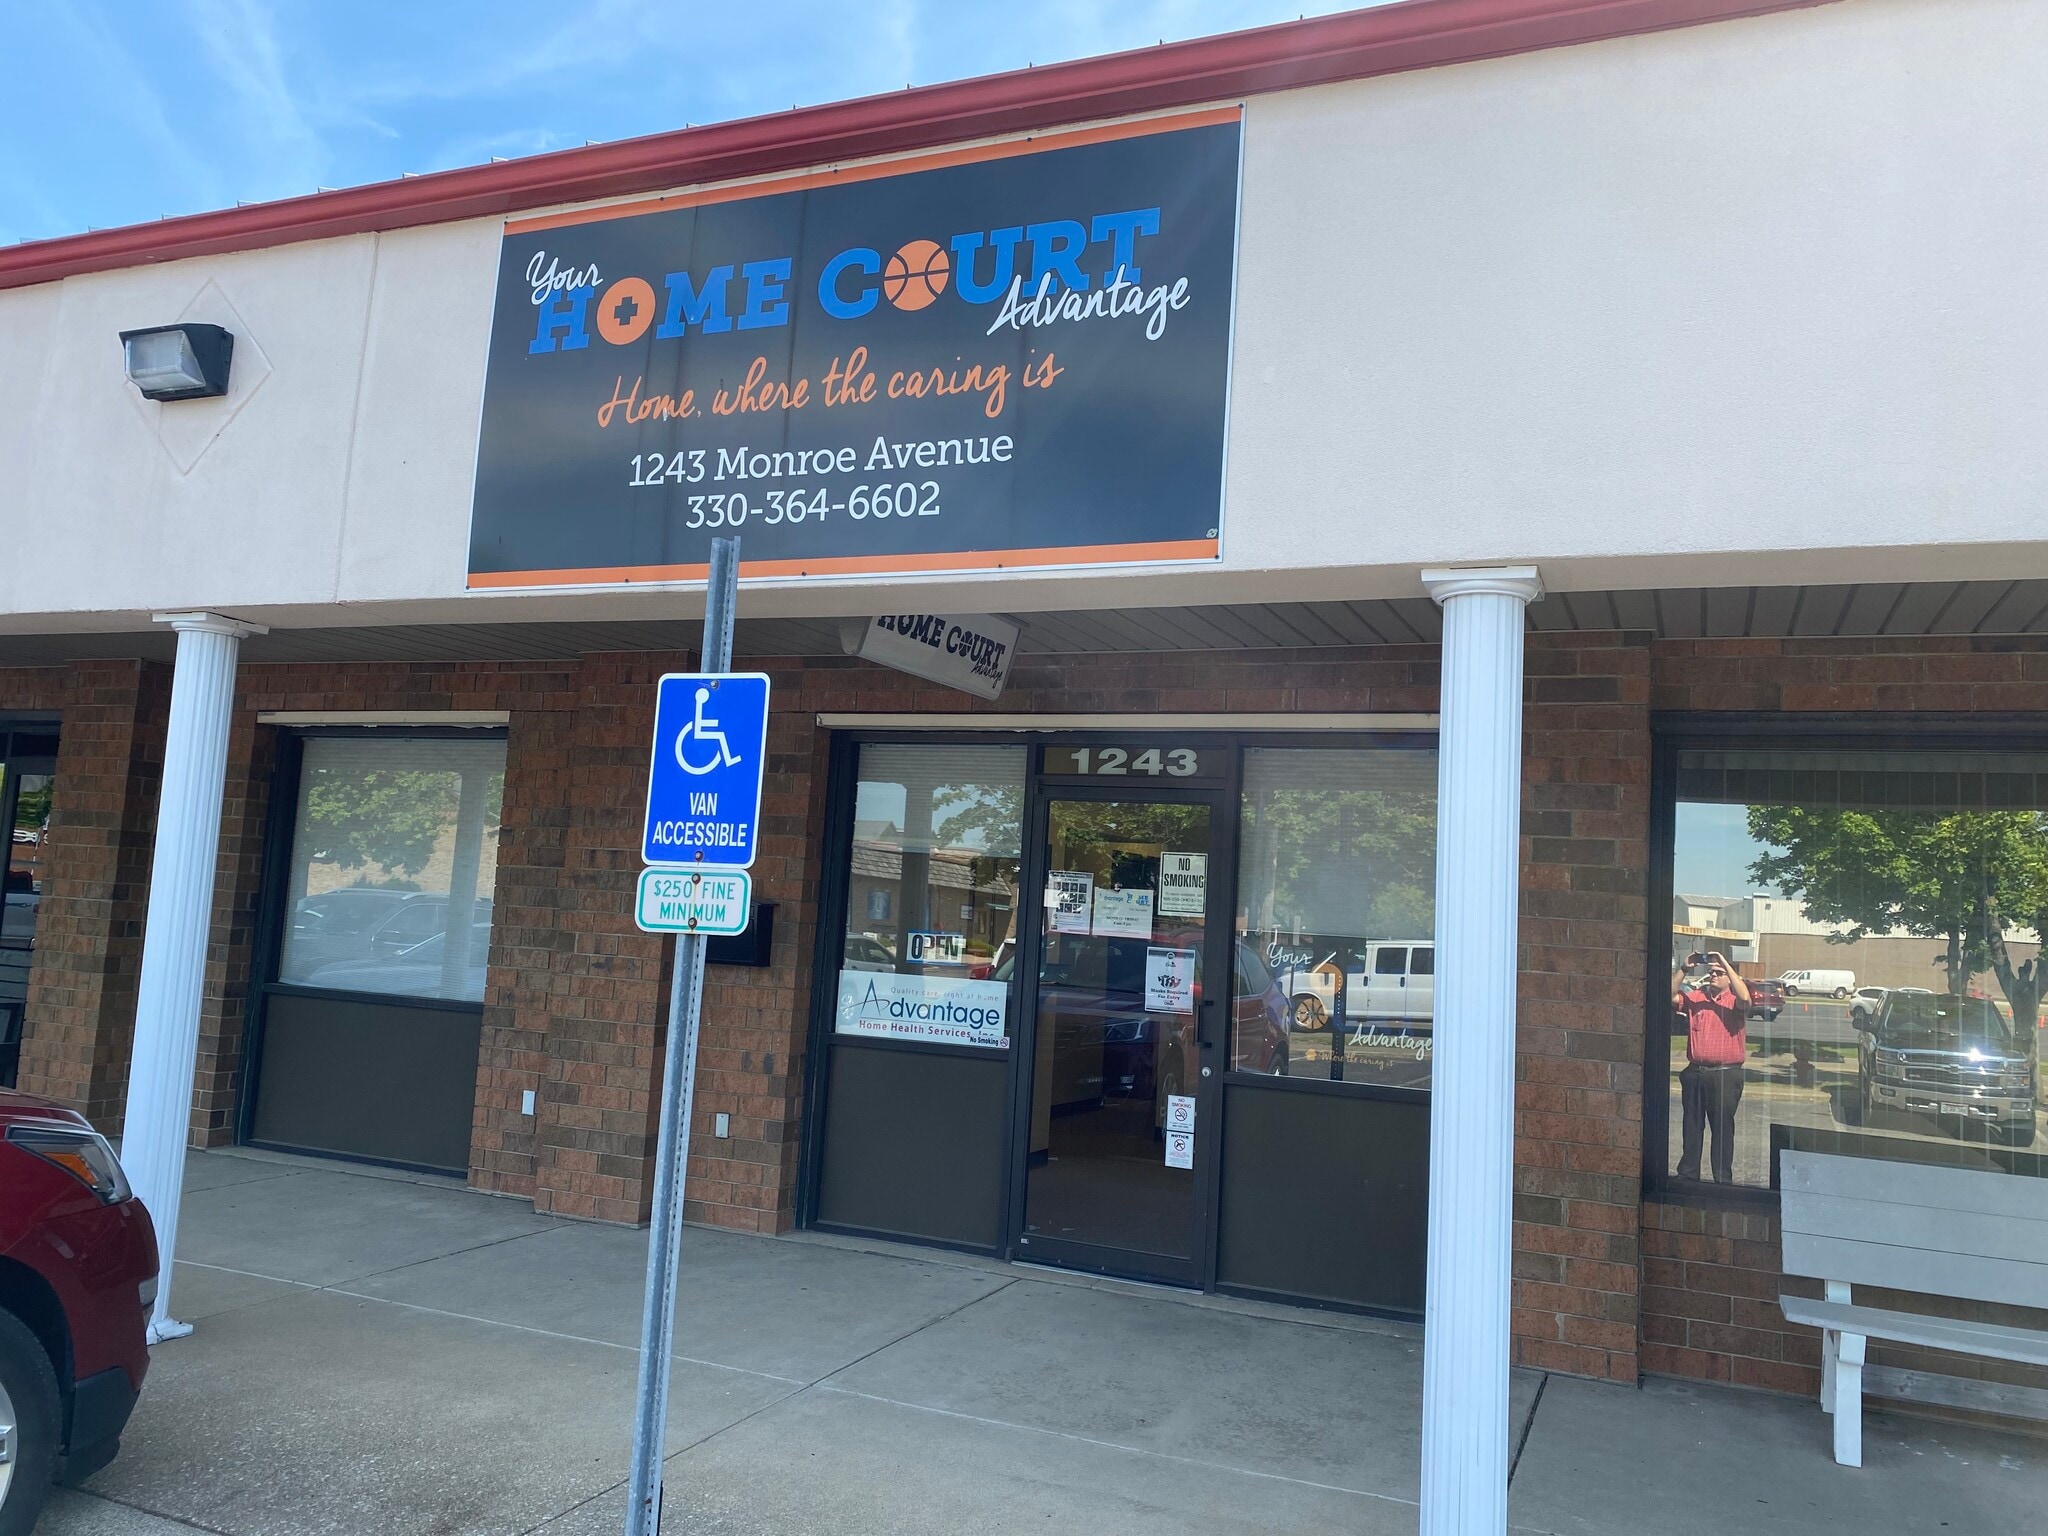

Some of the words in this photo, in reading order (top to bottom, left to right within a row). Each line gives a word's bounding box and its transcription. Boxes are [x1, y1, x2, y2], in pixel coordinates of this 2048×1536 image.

[526, 250, 603, 305] Your
[529, 257, 792, 354] HOME
[818, 207, 1160, 320] COURT
[987, 264, 1191, 340] Advantage
[598, 375, 701, 428] Home,
[712, 357, 809, 415] where
[822, 346, 876, 407] the
[887, 356, 1011, 418] caring
[1023, 348, 1065, 388] is
[629, 449, 706, 487] 1243
[713, 446, 856, 481] Monroe
[864, 434, 1014, 471] Avenue
[685, 480, 941, 529] 330-364-6602
[1071, 748, 1199, 777] 1243
[689, 792, 718, 816] VAN
[652, 821, 748, 847] ACCESSIBLE
[1178, 857, 1191, 871] NO
[653, 879, 693, 899] $250
[702, 881, 736, 901] FINE
[1163, 873, 1204, 889] SMOKING
[659, 902, 727, 922] MINIMUM
[1266, 941, 1314, 968] Your
[860, 978, 999, 1030] Advantage
[891, 987, 919, 996] Quality
[859, 1020, 888, 1031] Home
[890, 1022, 924, 1035] Health
[1348, 1022, 1433, 1061] Advantage
